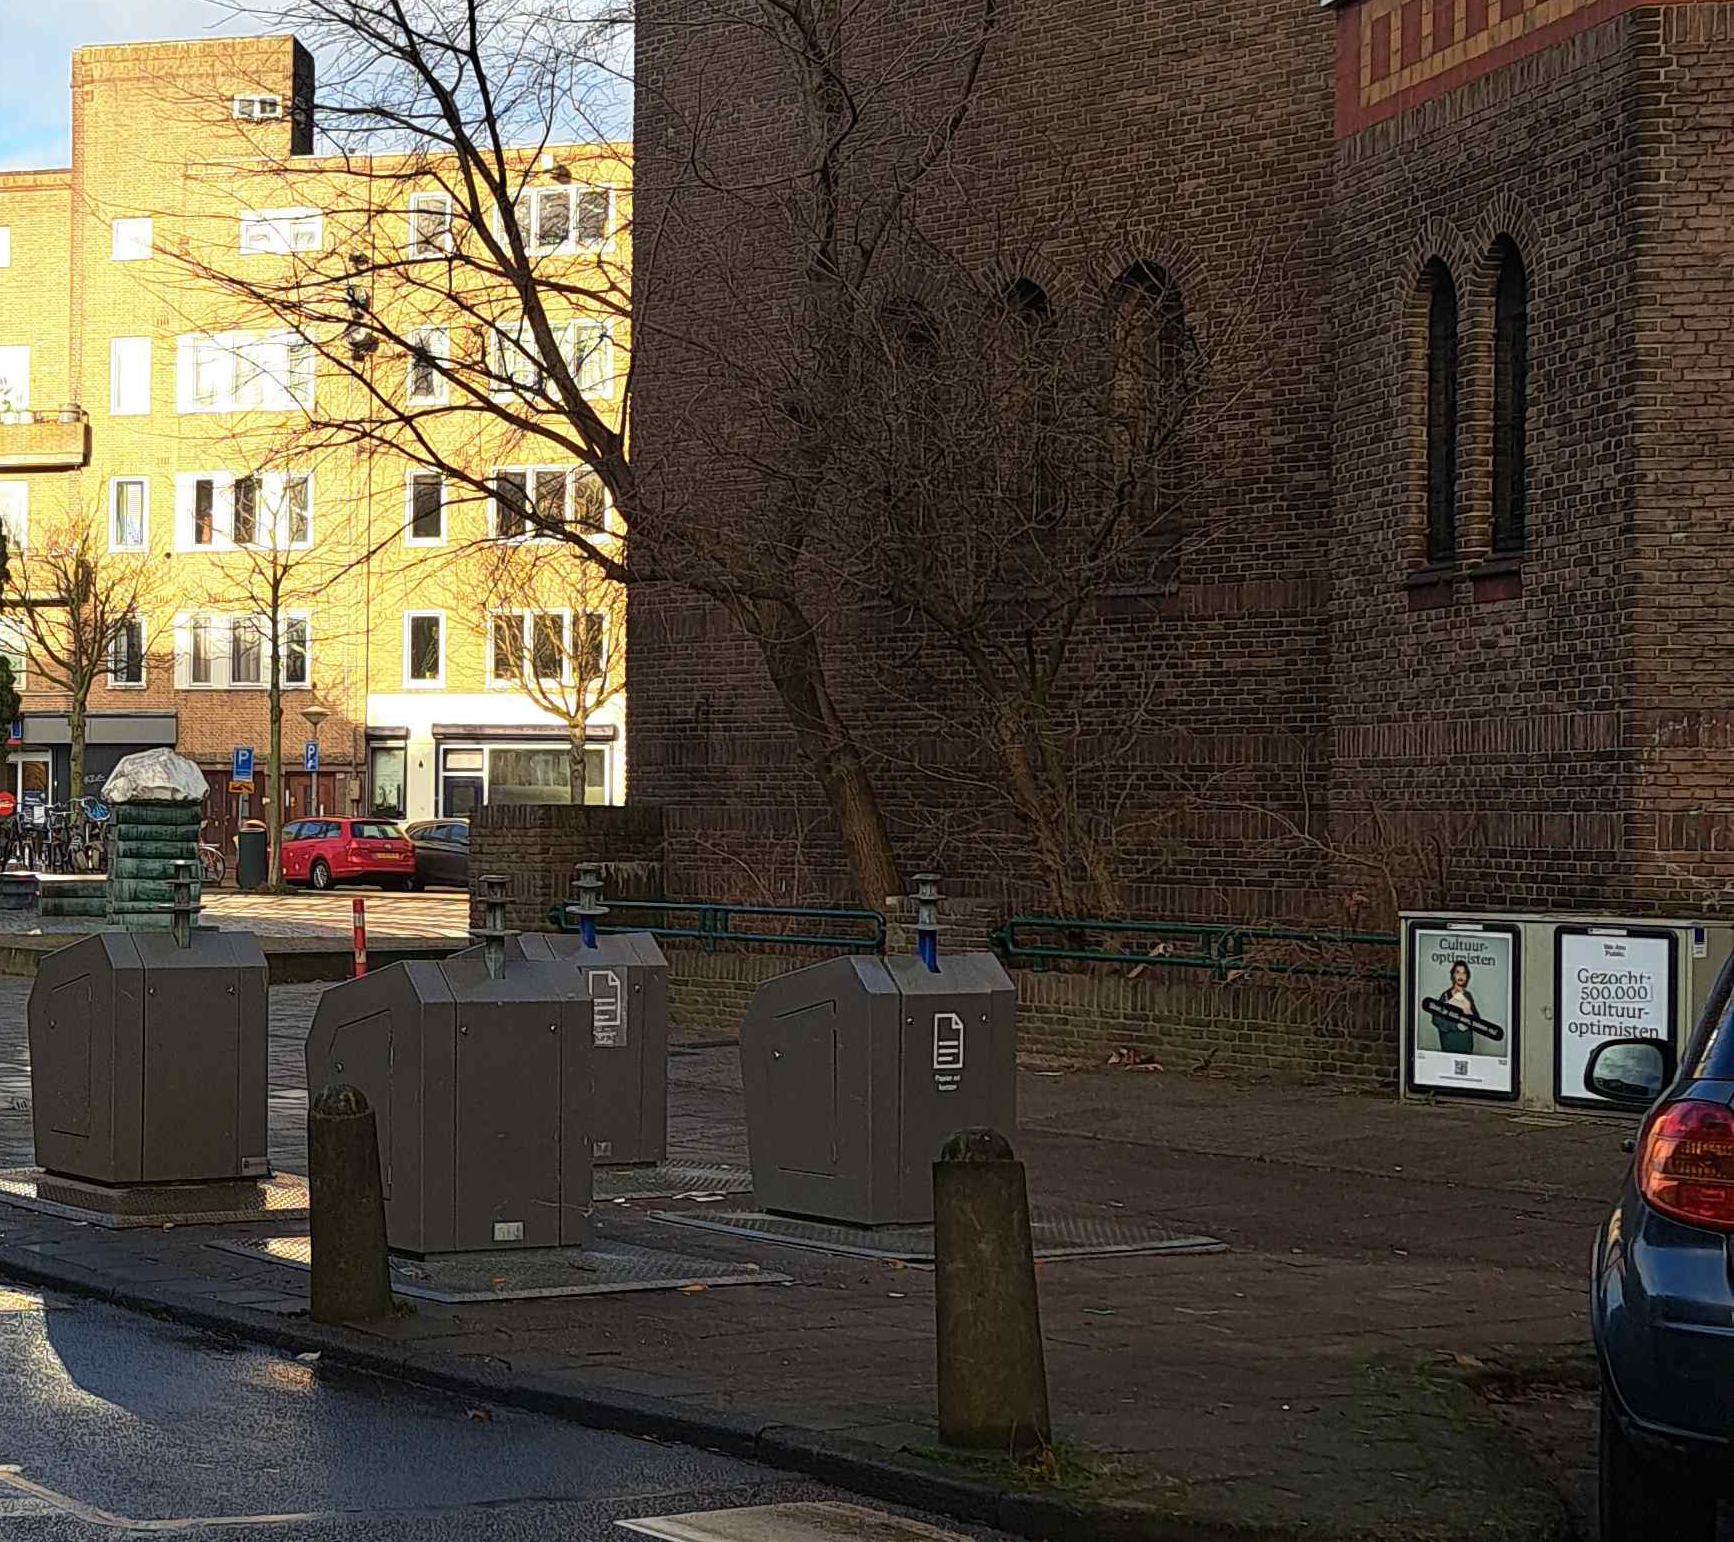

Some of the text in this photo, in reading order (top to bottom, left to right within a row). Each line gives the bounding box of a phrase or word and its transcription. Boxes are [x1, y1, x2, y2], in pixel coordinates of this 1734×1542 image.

[238, 750, 249, 765] P
[1439, 937, 1488, 952] Cultuur-
[1580, 985, 1648, 1000] 500.000
[1579, 1001, 1650, 1019] Cultuur-
[1568, 1019, 1659, 1039] optimisten
